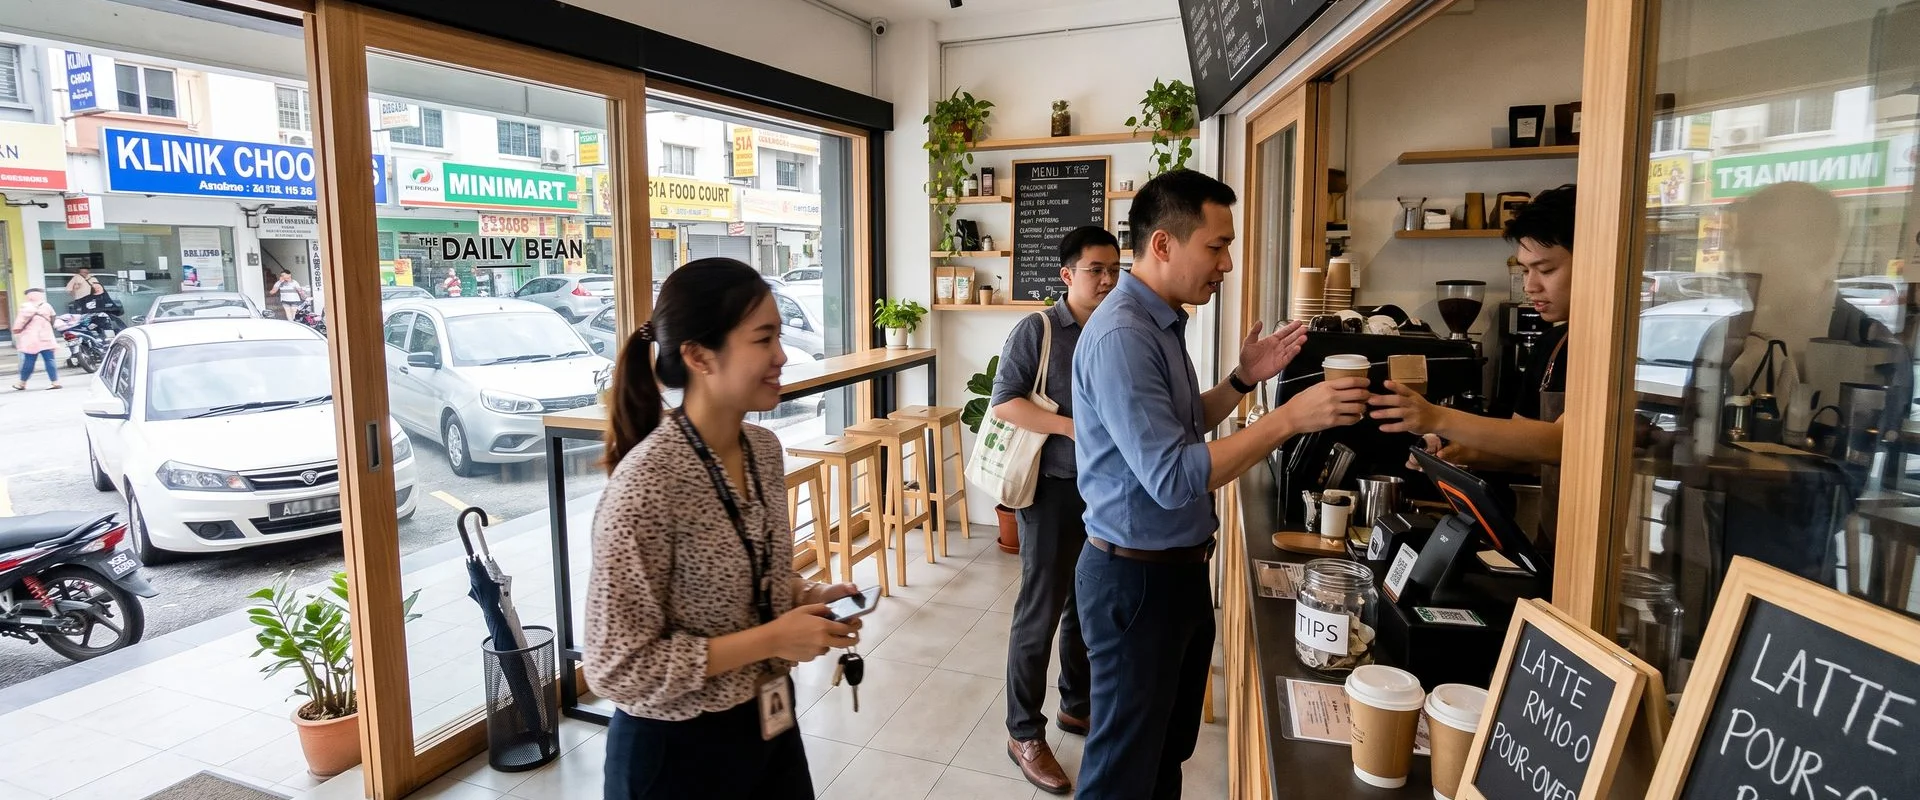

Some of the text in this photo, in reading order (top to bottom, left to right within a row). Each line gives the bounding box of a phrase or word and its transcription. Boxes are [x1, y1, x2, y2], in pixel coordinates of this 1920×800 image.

[735, 136, 753, 151] 51A
[116, 136, 315, 182] KLINIK CHOO
[1031, 166, 1059, 178] MENU
[450, 172, 567, 201] MINIMART
[669, 183, 696, 200] FOOD
[698, 185, 730, 203] COURT
[419, 237, 583, 260] THE DAILY BEAN
[1298, 612, 1338, 642] TIPS
[1520, 639, 1592, 710] LATTE
[1751, 633, 1917, 755] LATTE
[1720, 708, 1888, 800] POUR-
